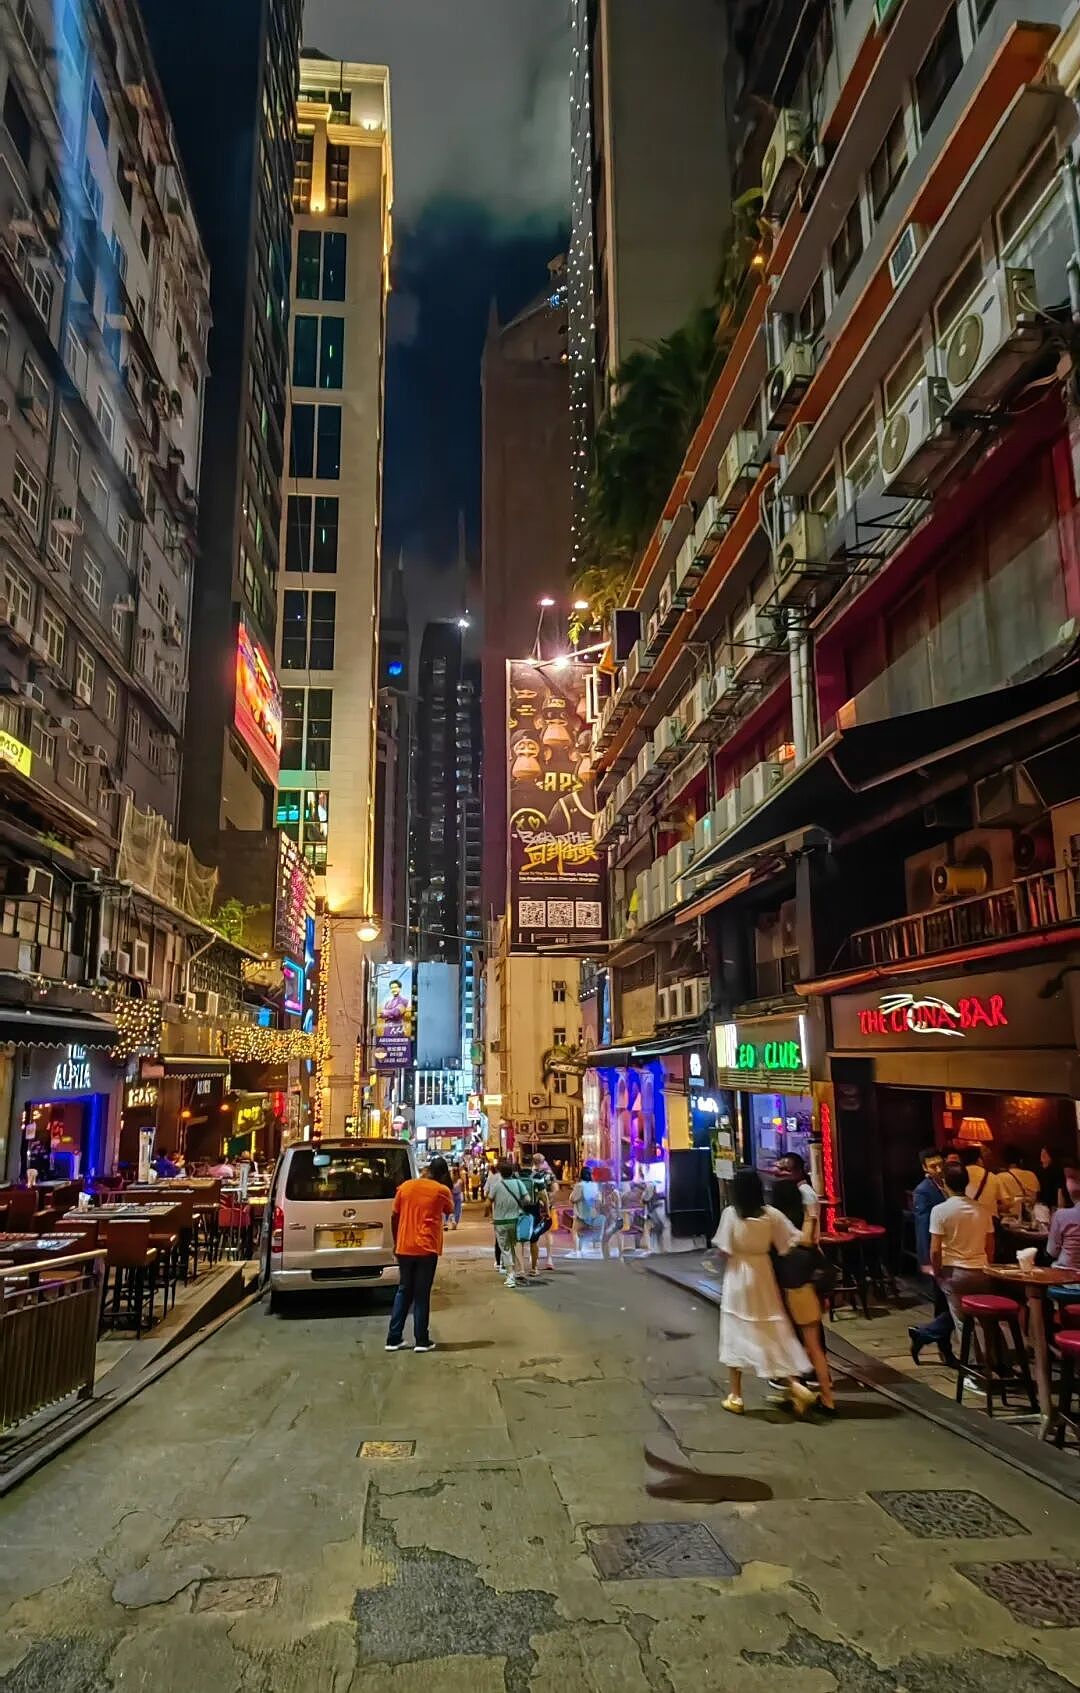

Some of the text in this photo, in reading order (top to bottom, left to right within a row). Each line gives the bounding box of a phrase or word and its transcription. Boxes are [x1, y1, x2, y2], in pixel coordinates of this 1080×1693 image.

[857, 1009, 888, 1035] THE
[958, 994, 1009, 1029] BAR
[736, 1040, 801, 1069] EO CLUB
[53, 1060, 92, 1090] ALPHA
